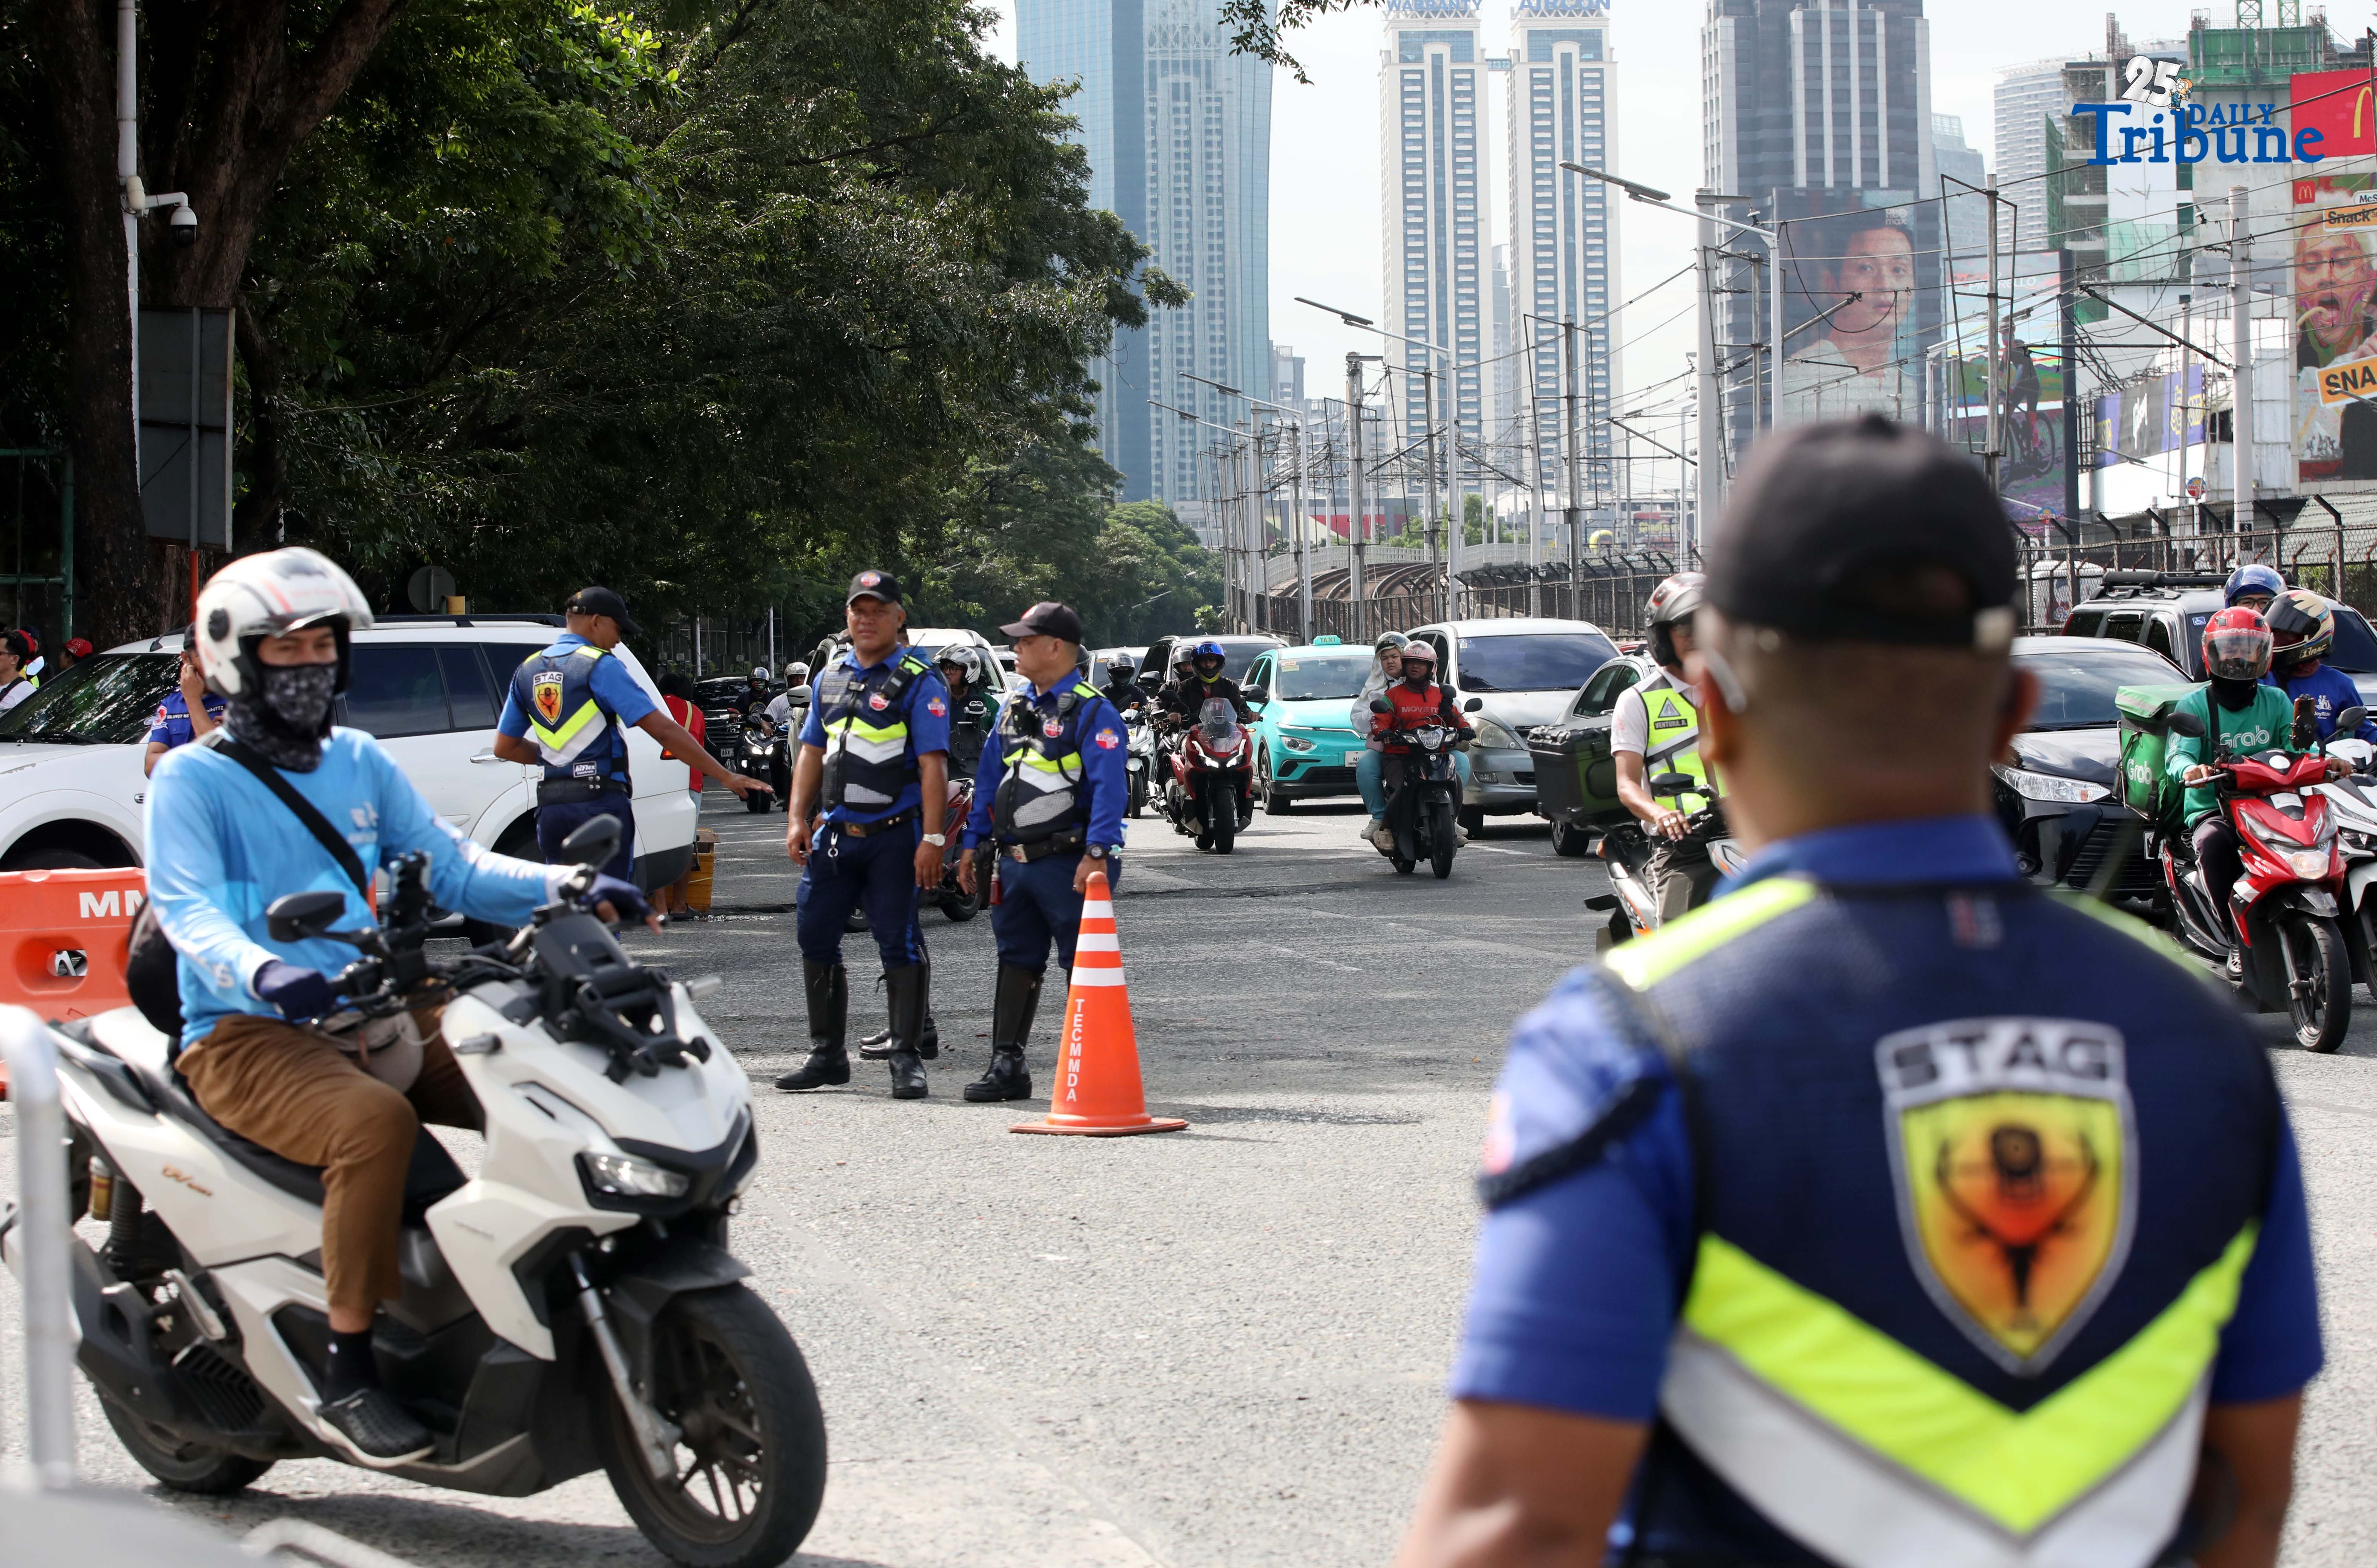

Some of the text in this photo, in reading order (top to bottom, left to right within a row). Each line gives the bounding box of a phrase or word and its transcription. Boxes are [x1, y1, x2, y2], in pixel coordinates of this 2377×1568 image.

[2328, 209, 2371, 224] Snack
[1968, 277, 2037, 291] PINRELLO
[535, 673, 562, 684] STAG
[2219, 725, 2270, 749] Grab
[2127, 758, 2152, 785] Grab
[2254, 861, 2272, 875] HONDA
[1893, 1031, 2109, 1088] STAG
